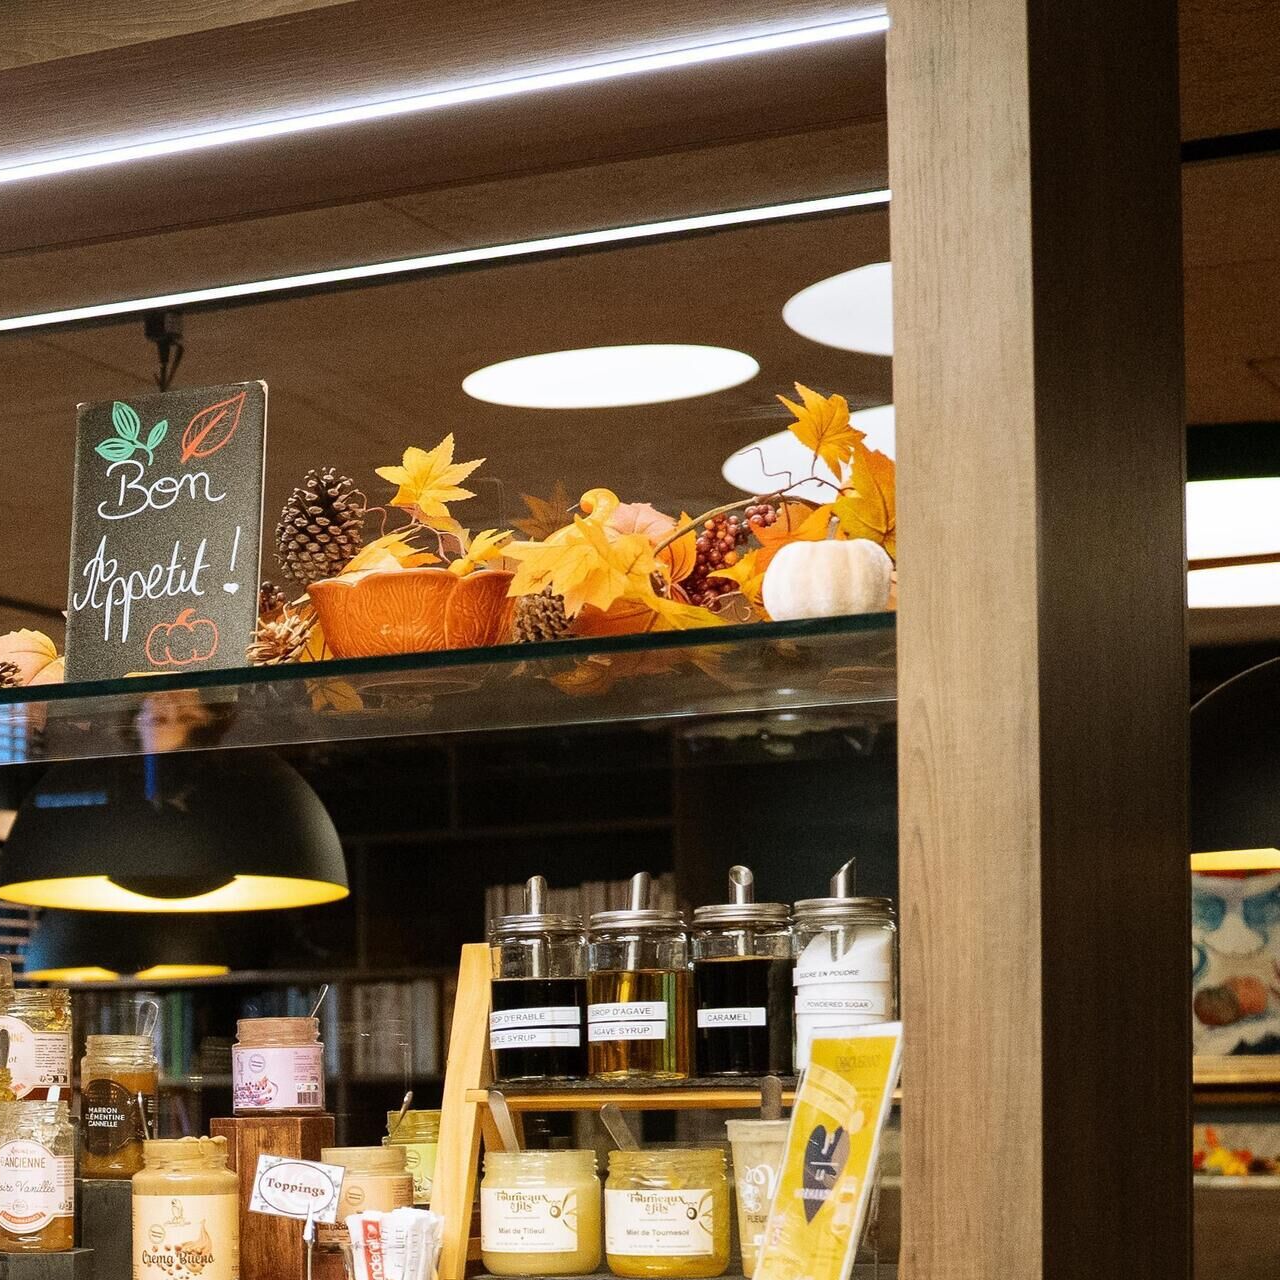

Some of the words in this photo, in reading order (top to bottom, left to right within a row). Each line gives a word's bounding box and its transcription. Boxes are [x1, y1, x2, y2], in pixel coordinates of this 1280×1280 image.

[96, 460, 226, 520] Bon
[73, 534, 210, 643] Appetit
[223, 526, 241, 595] !
[844, 1001, 869, 1009] SUGAR
[707, 1013, 749, 1022] CARAMEL
[618, 1026, 650, 1035] SYRUP
[507, 1034, 537, 1042] SYRUP
[88, 1106, 118, 1114] MARRON
[88, 1120, 118, 1128] CANNELLE
[4, 1156, 47, 1169] ANCIENNE
[267, 1177, 326, 1197] Toppings
[141, 1249, 175, 1265] Crema
[179, 1250, 216, 1265] Bueno
